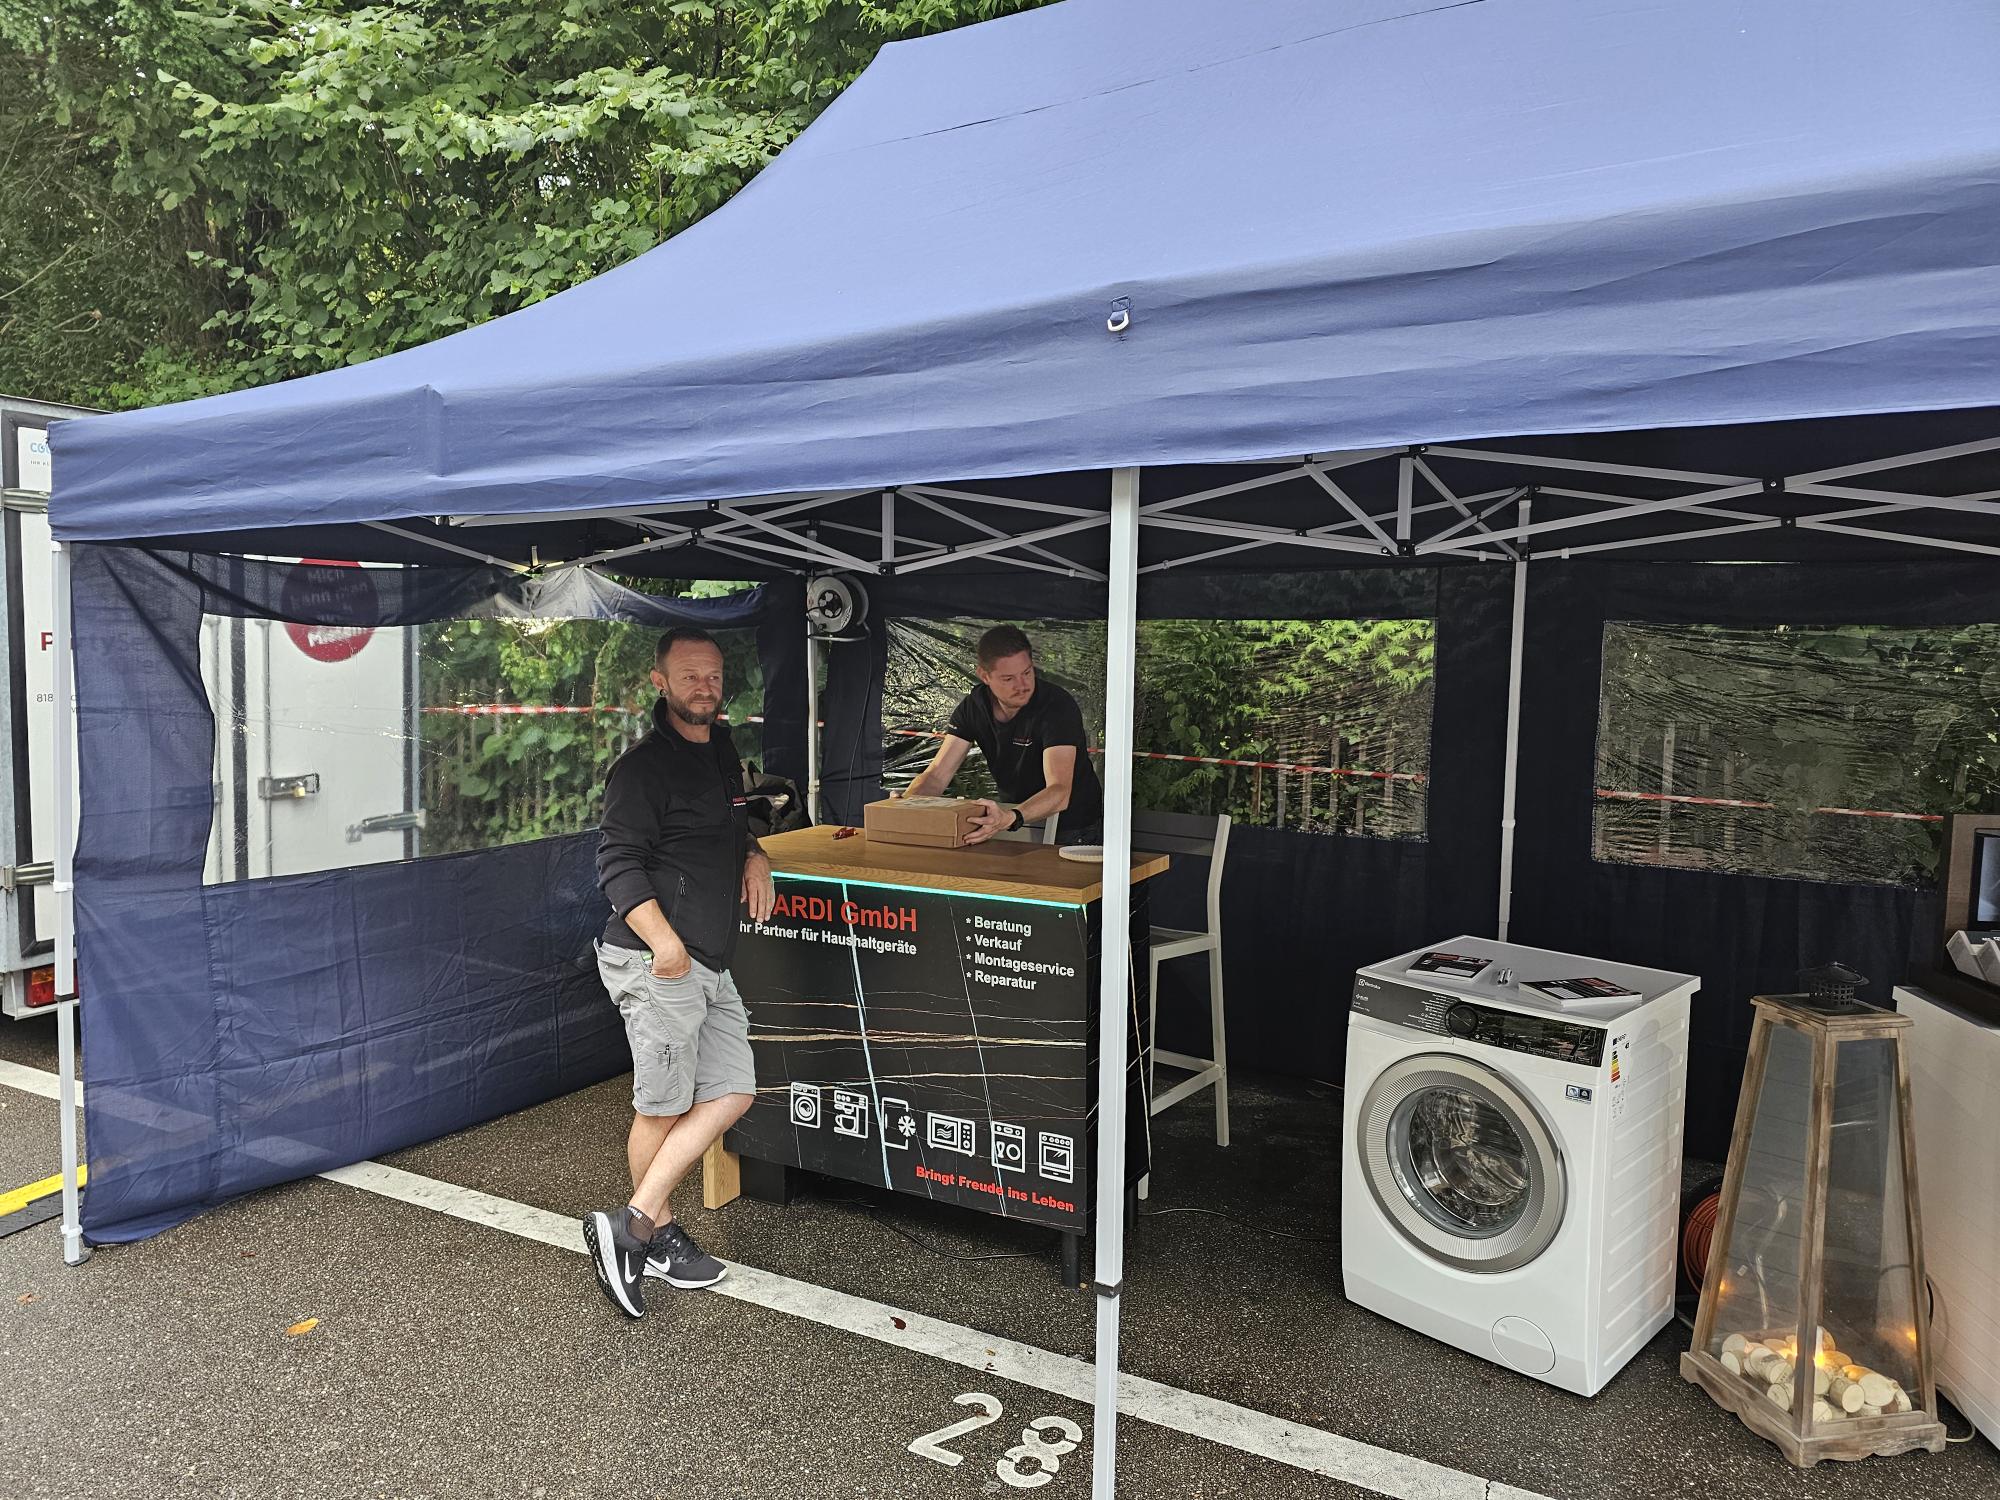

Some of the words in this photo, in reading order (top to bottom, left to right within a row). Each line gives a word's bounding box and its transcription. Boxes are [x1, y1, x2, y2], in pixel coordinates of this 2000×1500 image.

[36, 693, 54, 703] 818
[772, 893, 833, 922] ARDI
[840, 901, 918, 932] GmbH
[739, 920, 752, 934] hr
[754, 921, 799, 939] Partner
[800, 927, 819, 942] für
[821, 929, 918, 955] Haushaltgeräte
[974, 915, 1032, 937] Beratung
[974, 933, 1023, 951] Verkauf
[974, 951, 1075, 977] Montageservice
[974, 969, 1037, 990] Reparatur
[915, 1166, 956, 1186] Bringt
[958, 1175, 1004, 1196] Freude
[1007, 1186, 1029, 1201] ins
[1031, 1191, 1075, 1213] Leben
[907, 1392, 1083, 1488] 28
